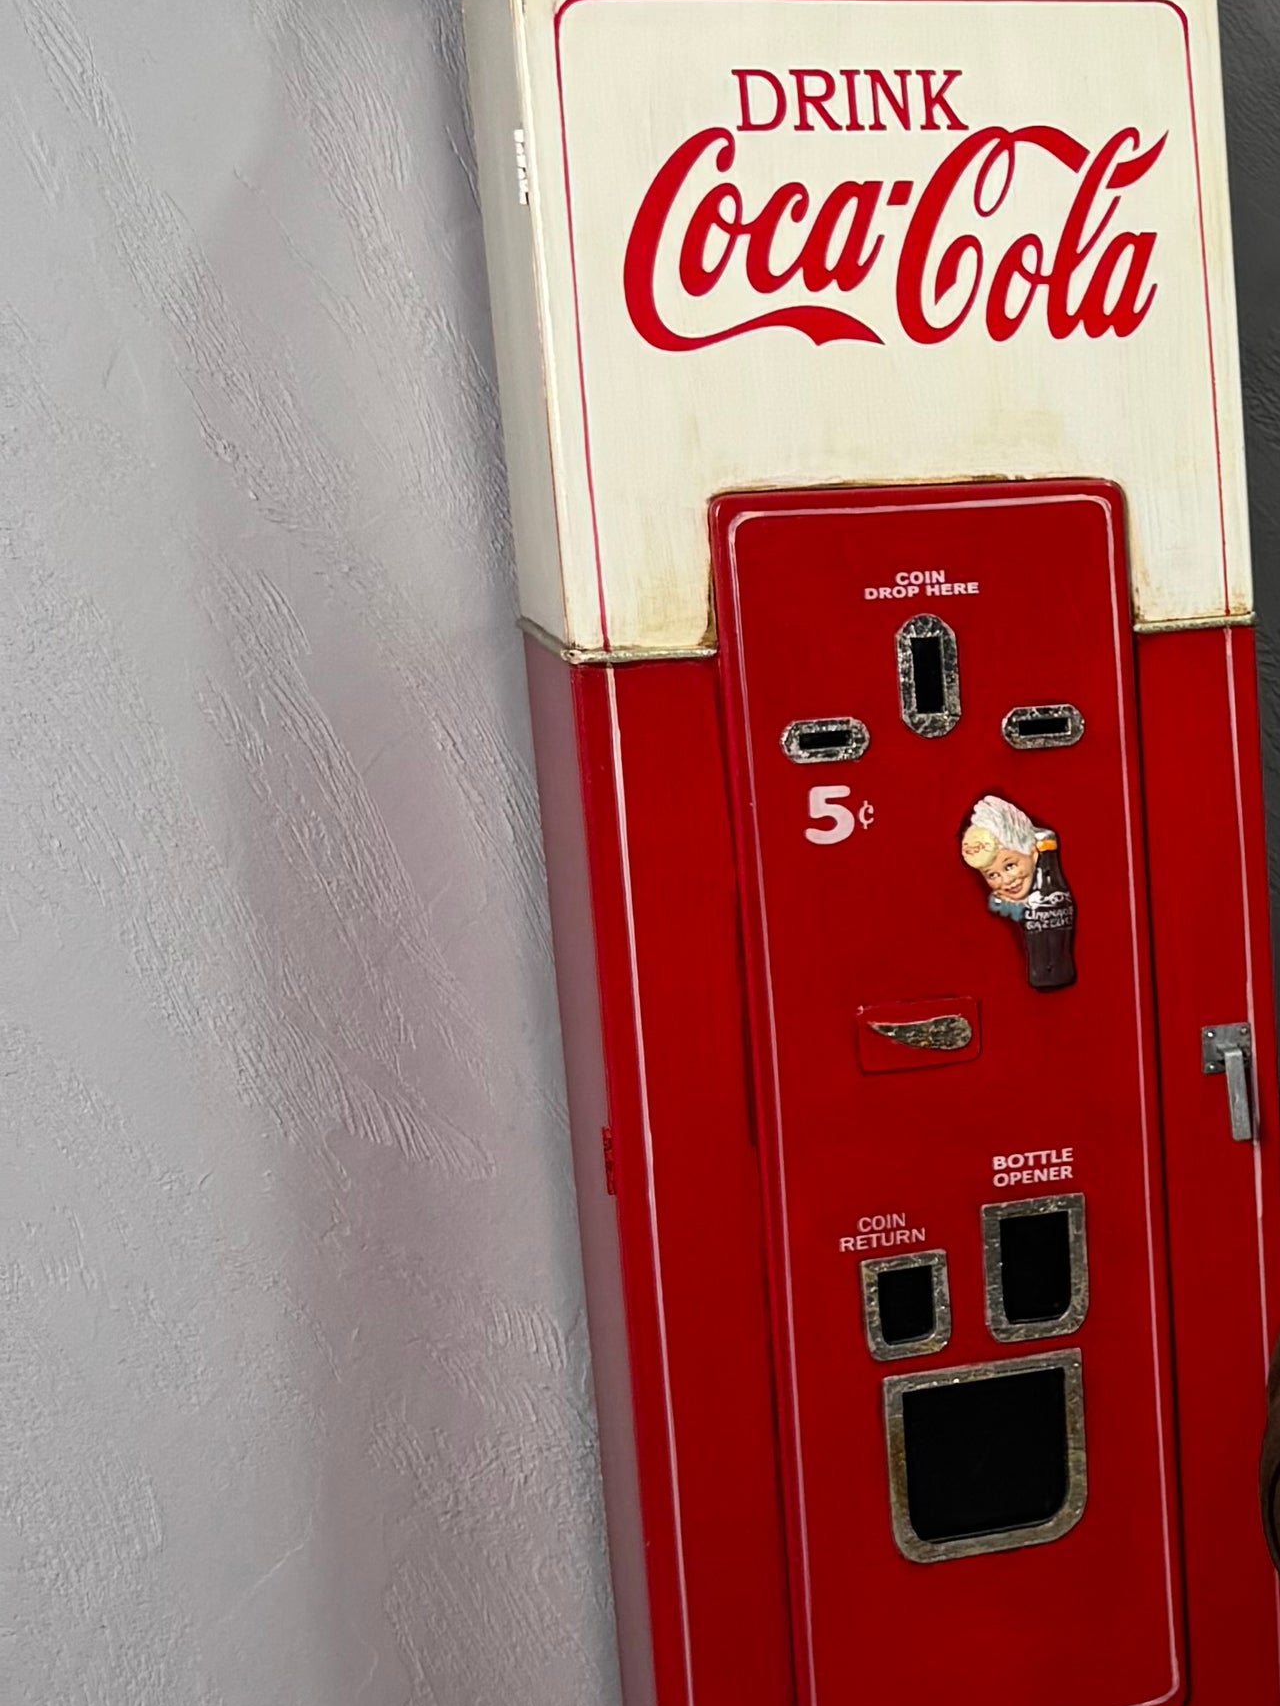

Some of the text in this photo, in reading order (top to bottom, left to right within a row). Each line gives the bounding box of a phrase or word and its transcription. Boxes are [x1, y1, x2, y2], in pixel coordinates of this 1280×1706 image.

[731, 68, 969, 133] DRINK
[623, 125, 1168, 352] Coca-Cola
[895, 570, 946, 586] COIN
[864, 582, 980, 600] DROP HERE
[805, 785, 874, 845] 5¢
[992, 1148, 1074, 1171] BOTTLE
[993, 1166, 1073, 1187] OPENER
[857, 1212, 906, 1233] COIN
[839, 1228, 926, 1252] RETURN
